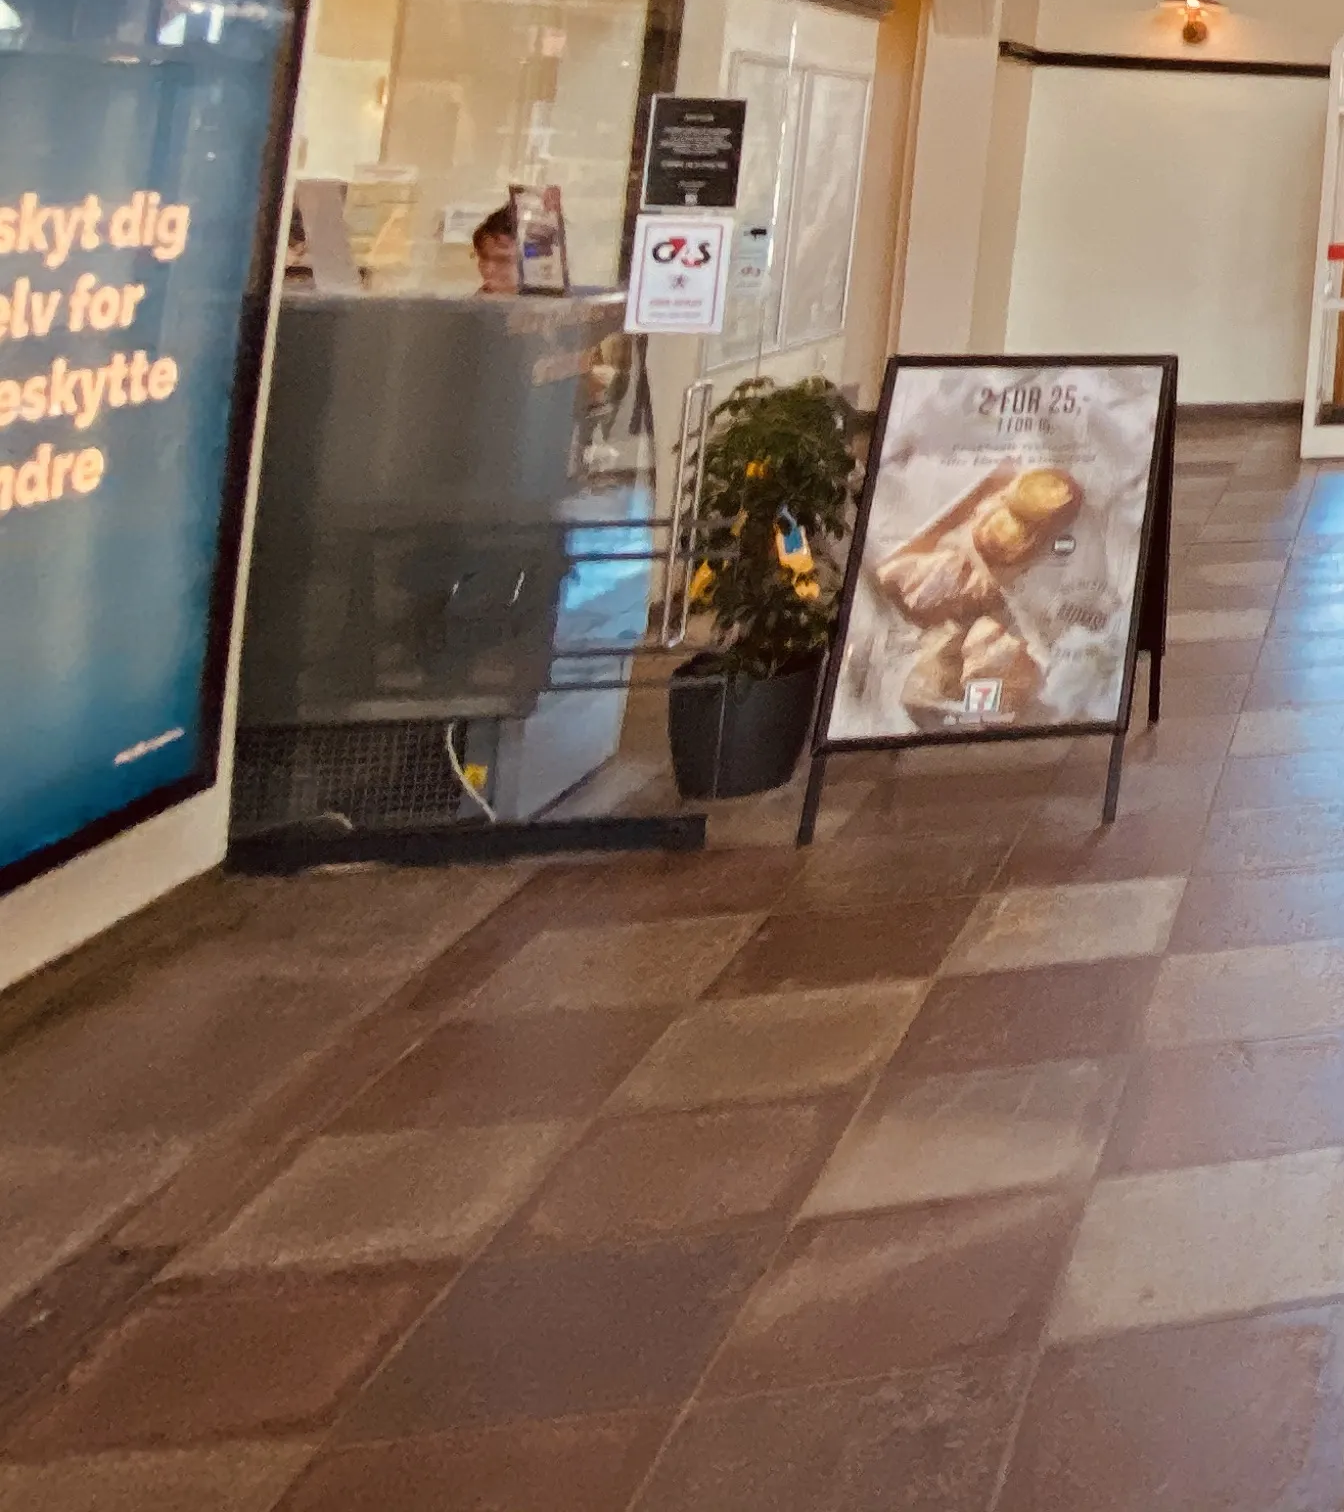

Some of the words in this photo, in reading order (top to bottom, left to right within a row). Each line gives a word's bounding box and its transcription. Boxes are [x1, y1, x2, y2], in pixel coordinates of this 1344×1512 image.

[110, 191, 191, 262] dig
[68, 273, 147, 333] for
[977, 387, 996, 416] 2
[999, 387, 1042, 415] FOR
